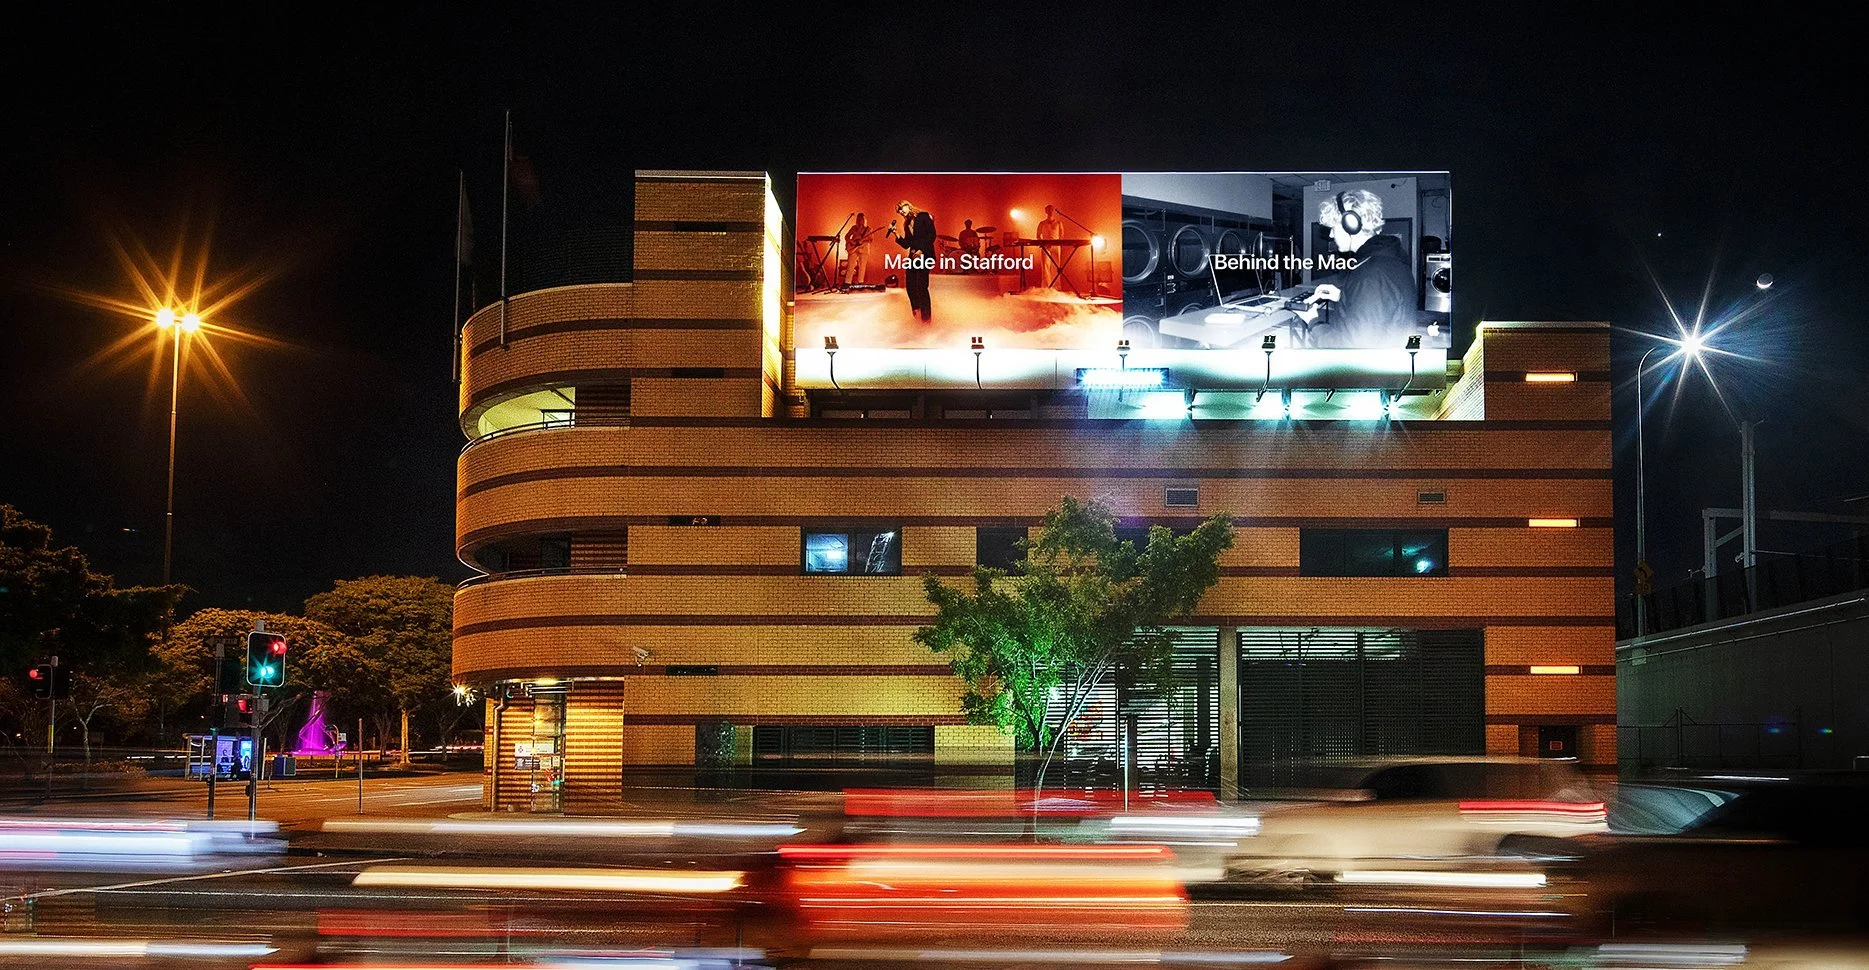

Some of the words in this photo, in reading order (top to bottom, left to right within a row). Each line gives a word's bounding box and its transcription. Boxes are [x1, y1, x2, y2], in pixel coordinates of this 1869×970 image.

[884, 253, 936, 270] Made
[939, 253, 956, 270] in
[960, 253, 1034, 270] Stafford
[1214, 253, 1279, 270] Behind
[1283, 253, 1314, 270] the
[1318, 253, 1358, 270] Mac
